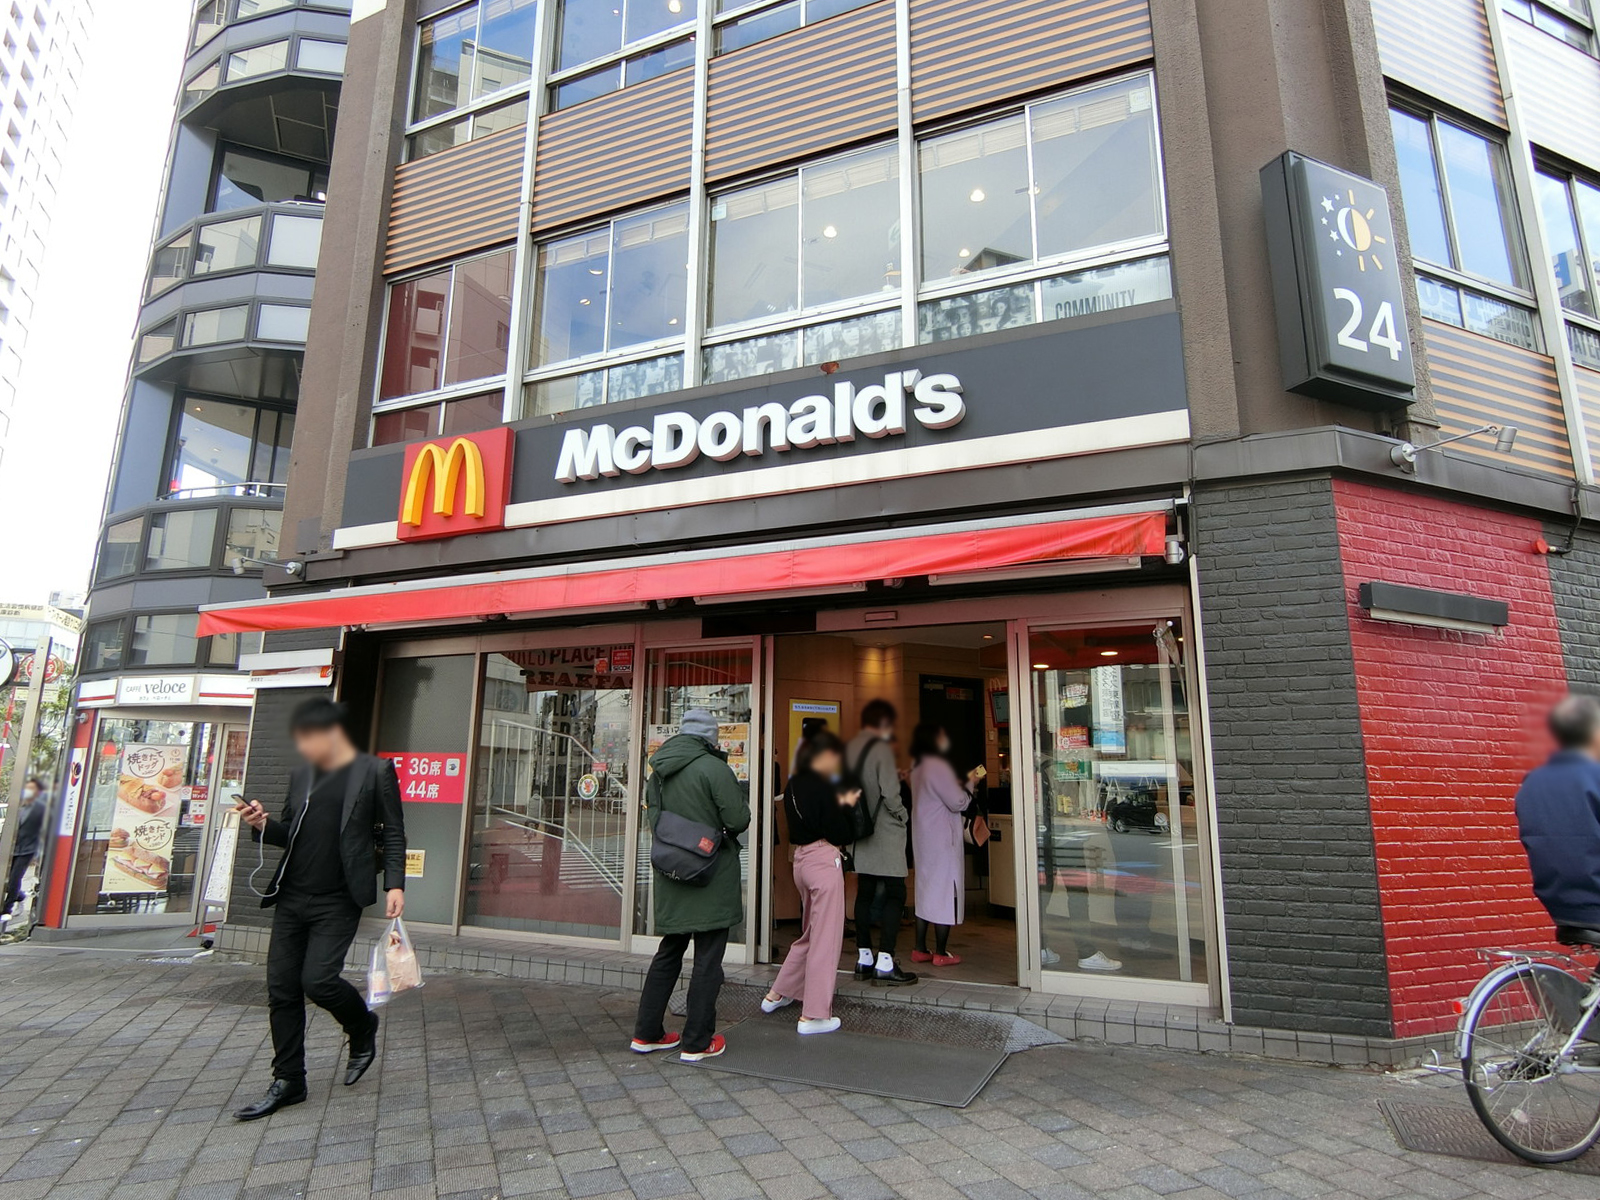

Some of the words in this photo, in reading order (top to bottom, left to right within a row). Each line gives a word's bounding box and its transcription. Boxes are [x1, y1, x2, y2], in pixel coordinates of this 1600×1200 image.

[1055, 288, 1136, 320] COMMUNITY
[1333, 287, 1402, 362] 24
[554, 368, 966, 483] McDonald's
[144, 679, 187, 694] veloce
[127, 751, 164, 766] 焼きたて
[409, 757, 442, 777] 36席
[406, 780, 440, 800] 44席
[134, 822, 172, 838] 焼きたて
